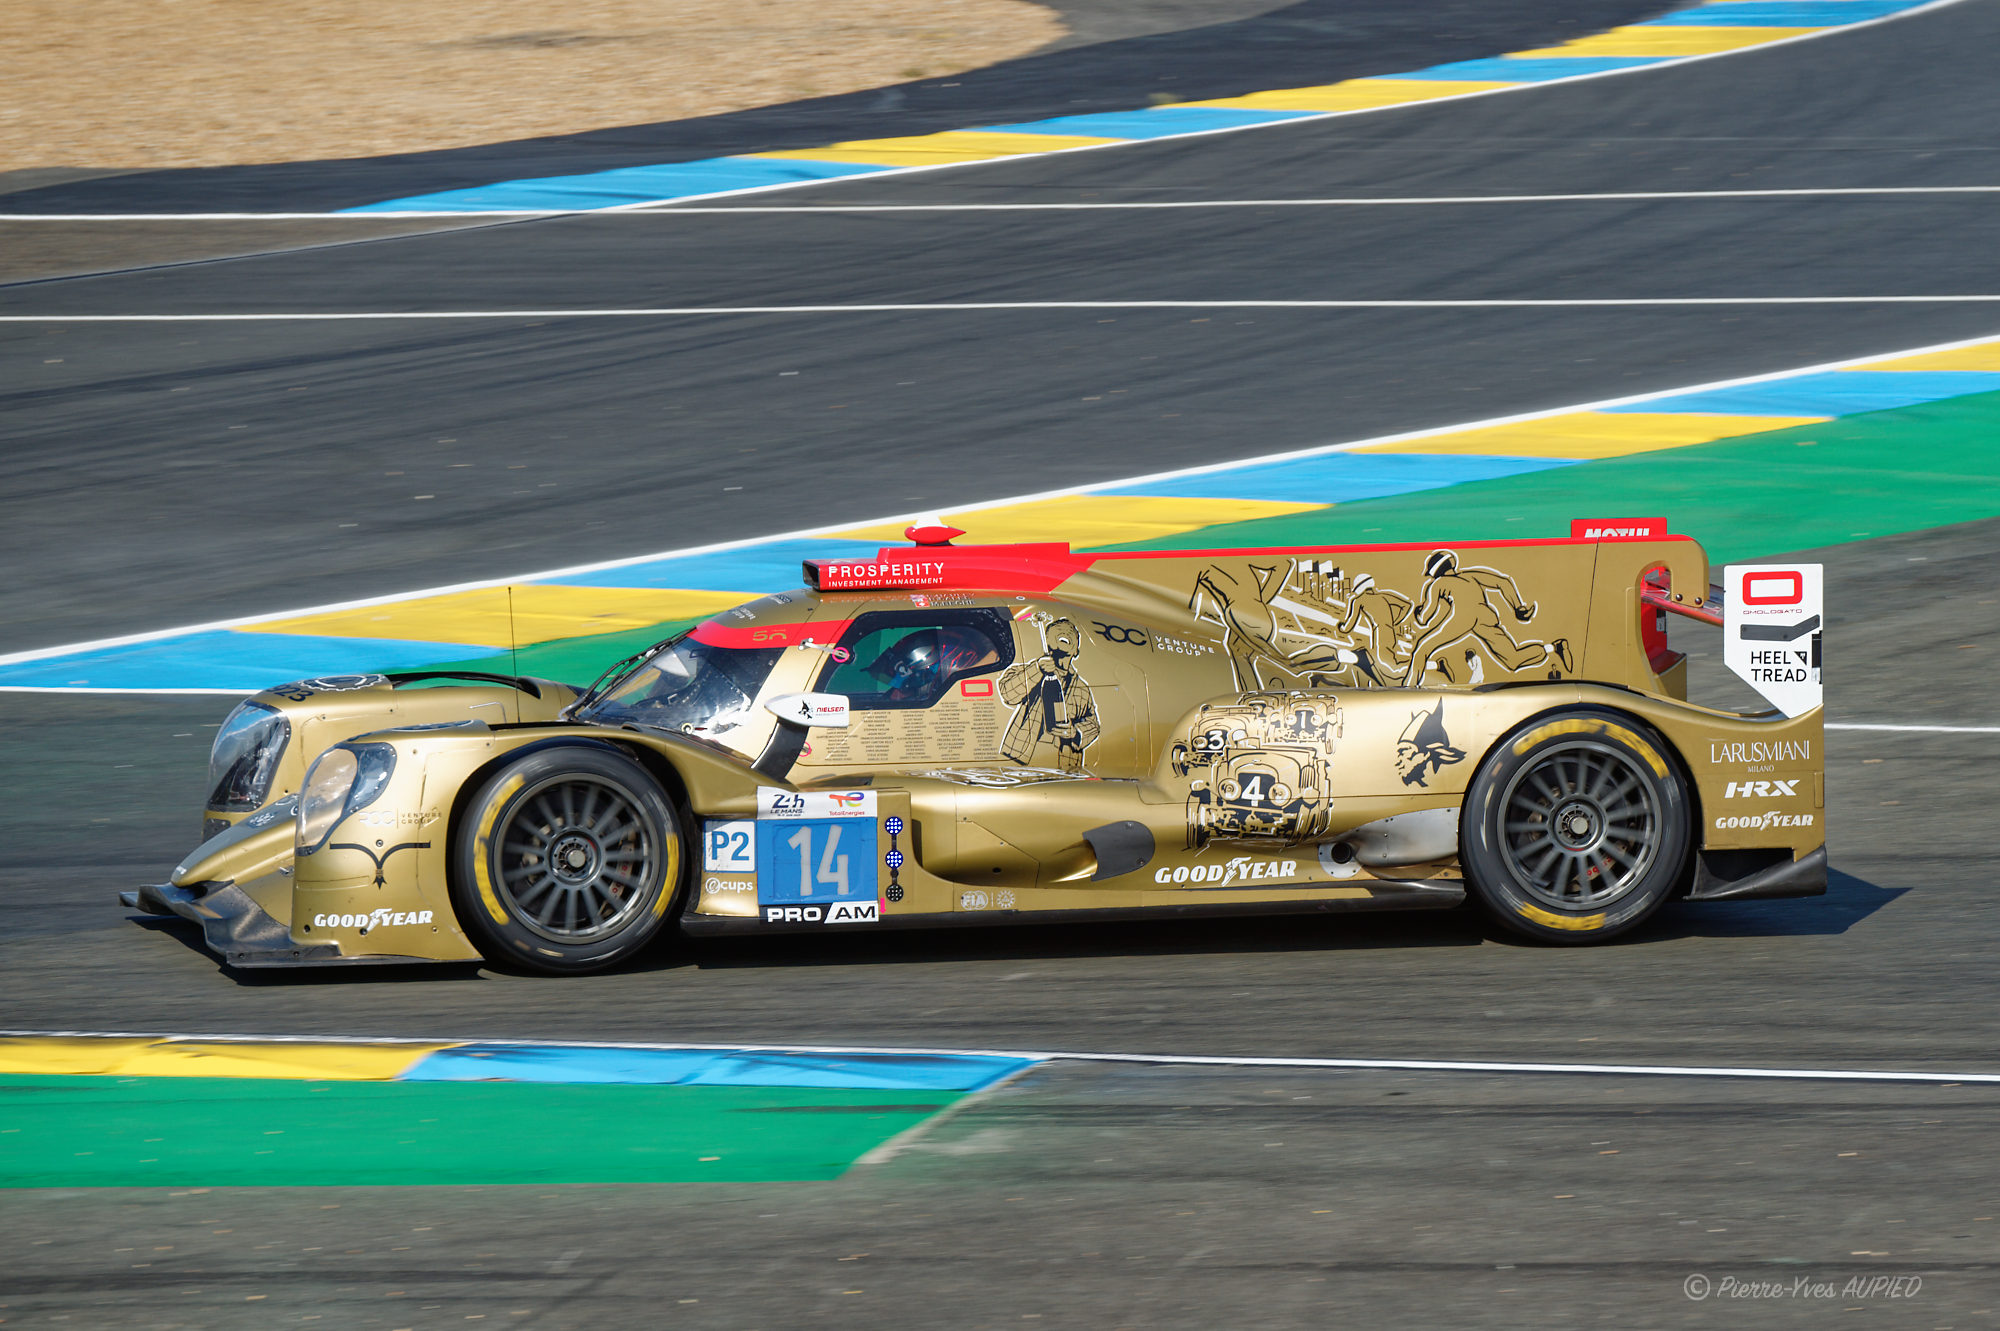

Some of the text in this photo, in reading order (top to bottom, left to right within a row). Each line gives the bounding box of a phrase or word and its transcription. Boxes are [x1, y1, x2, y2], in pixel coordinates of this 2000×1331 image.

[828, 562, 944, 578] PROSPERITY
[886, 577, 943, 585] MANAGEMENT
[1091, 620, 1147, 646] ROC
[1155, 635, 1215, 654] VENTURE
[1157, 643, 1201, 656] GROUP
[1751, 651, 1791, 664] HEEL
[1751, 668, 1807, 682] TREAD
[1299, 711, 1307, 728] 1
[1208, 730, 1224, 749] 3
[1711, 740, 1810, 763] LARUSMIANI
[1241, 776, 1264, 807] 4
[1724, 780, 1800, 798] HRX
[711, 831, 749, 861] P2
[788, 825, 848, 896] 14
[767, 906, 876, 922] PRO AM
